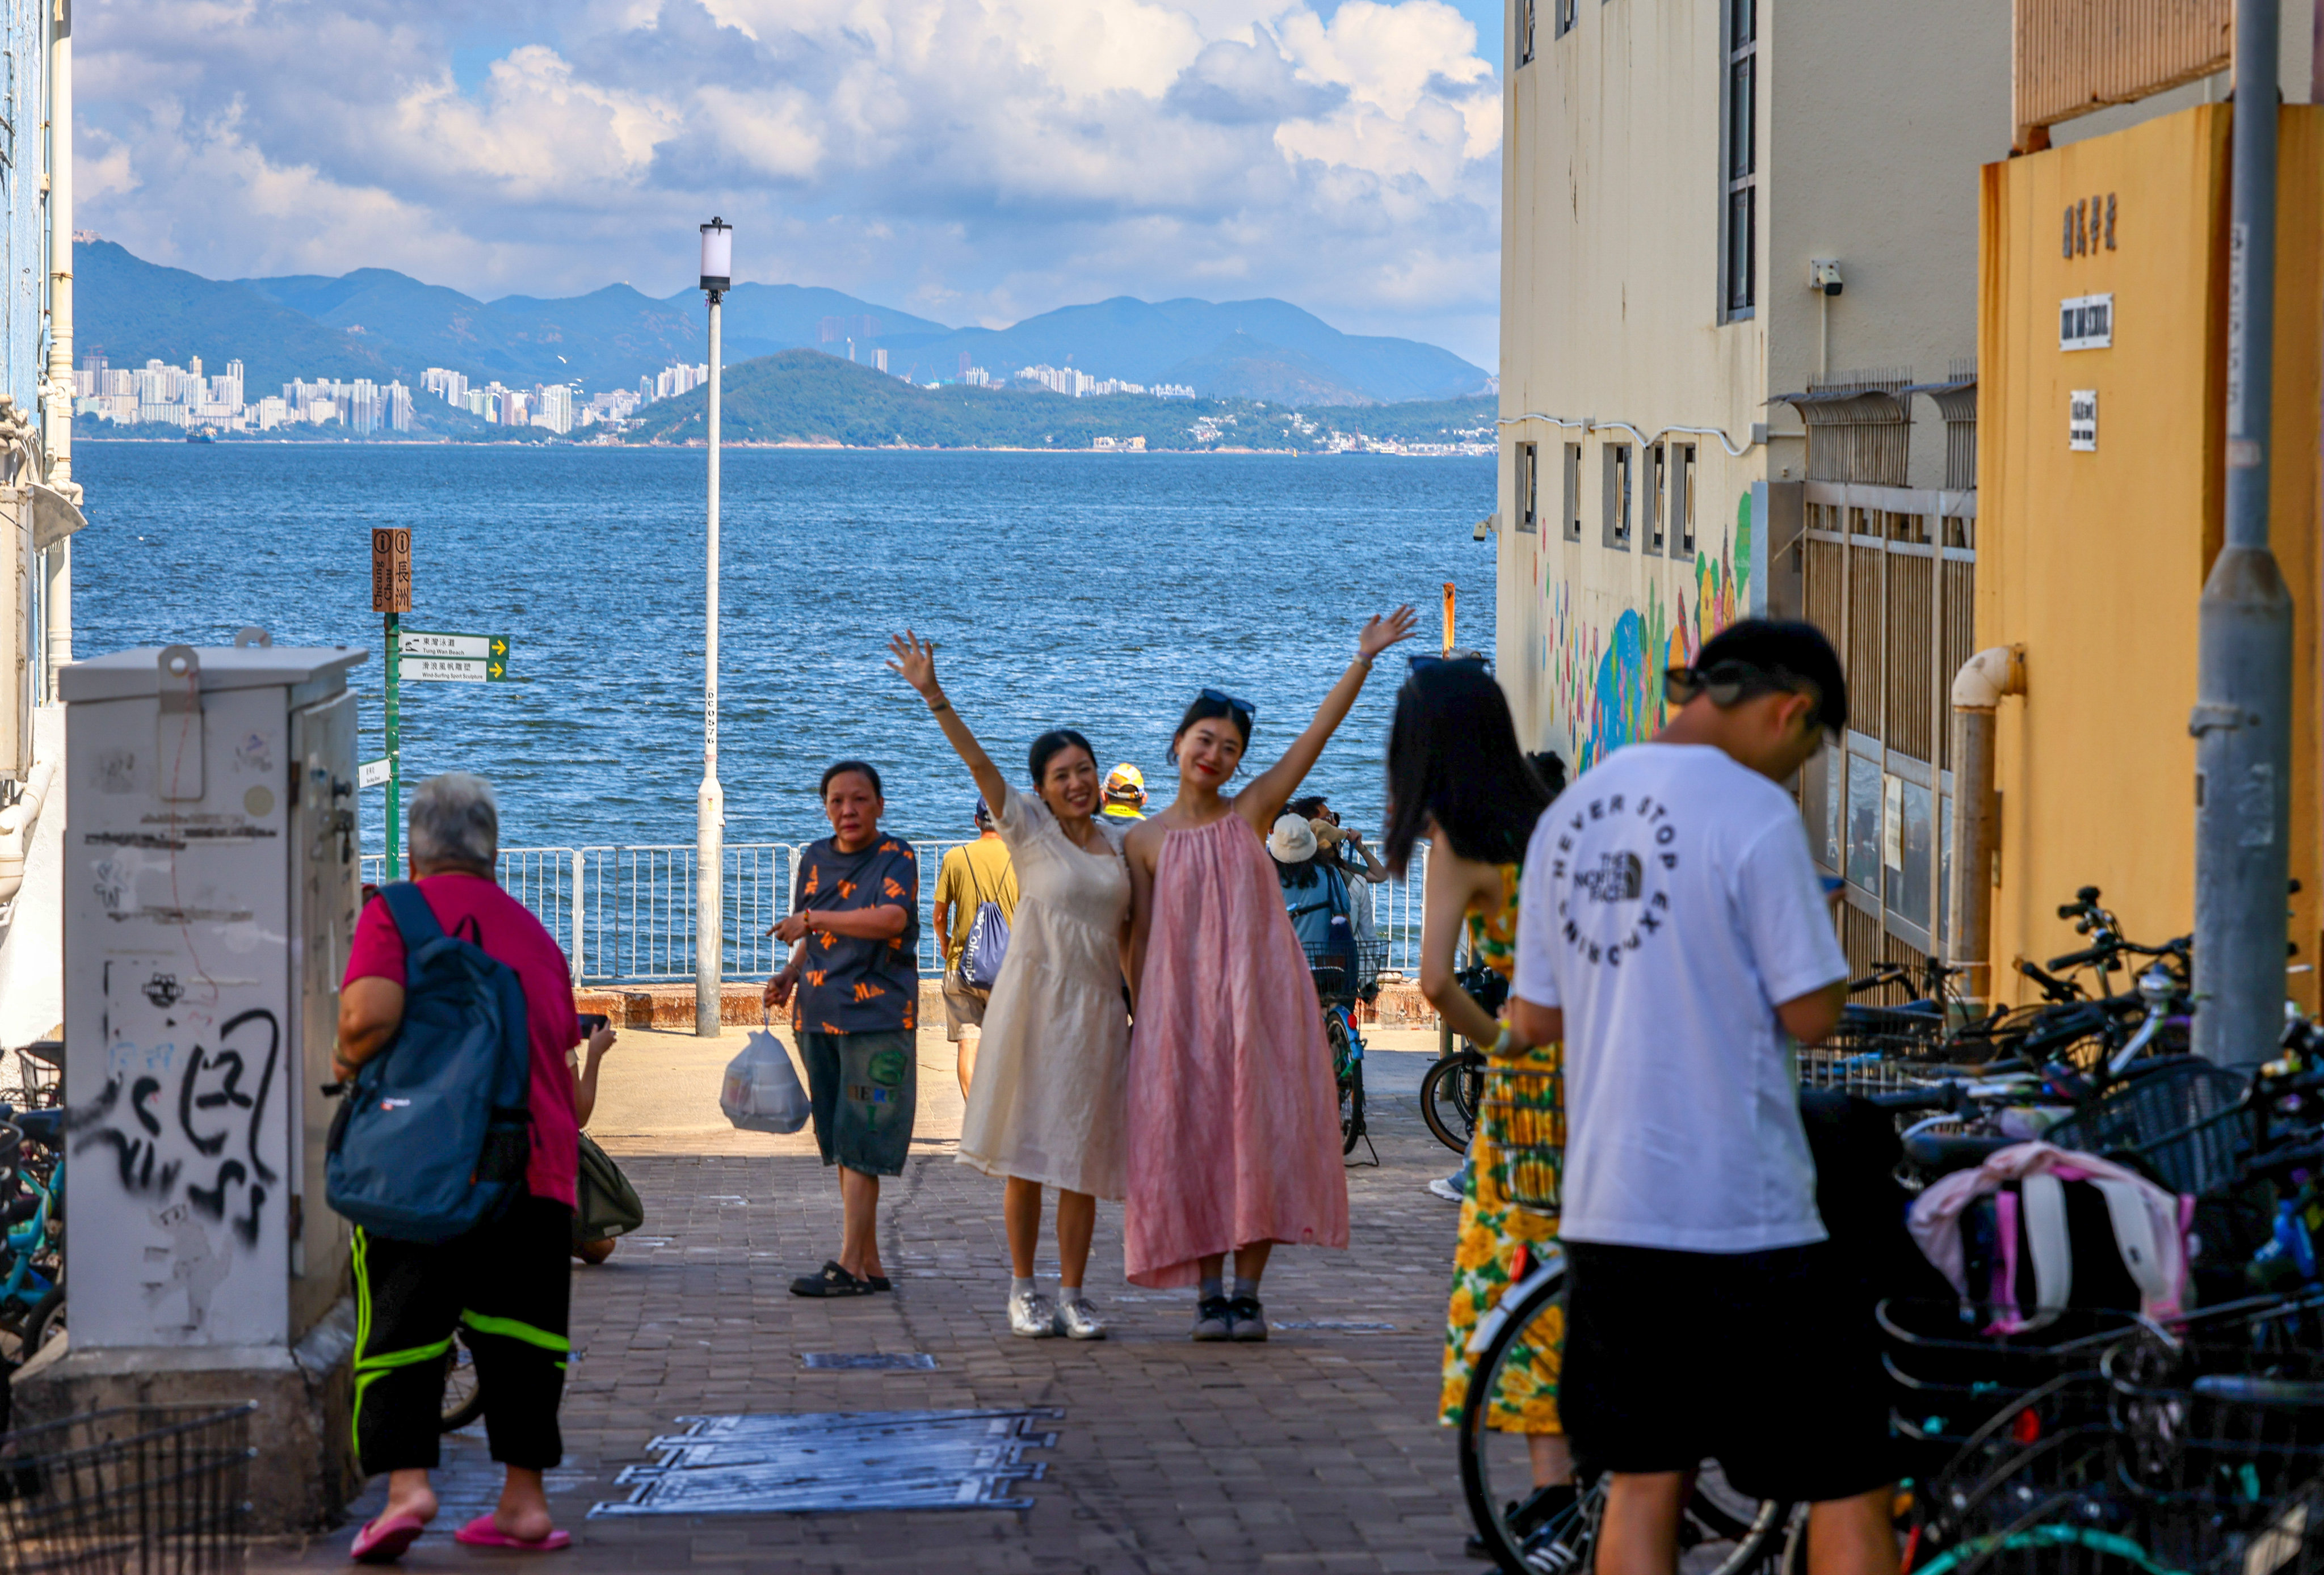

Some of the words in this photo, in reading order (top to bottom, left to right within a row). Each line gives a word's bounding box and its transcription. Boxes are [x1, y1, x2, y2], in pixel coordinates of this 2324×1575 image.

[375, 561, 384, 607] Cheung
[396, 561, 409, 607] 長洲
[1552, 794, 1624, 879] NEVER
[1636, 796, 1679, 871] STOP
